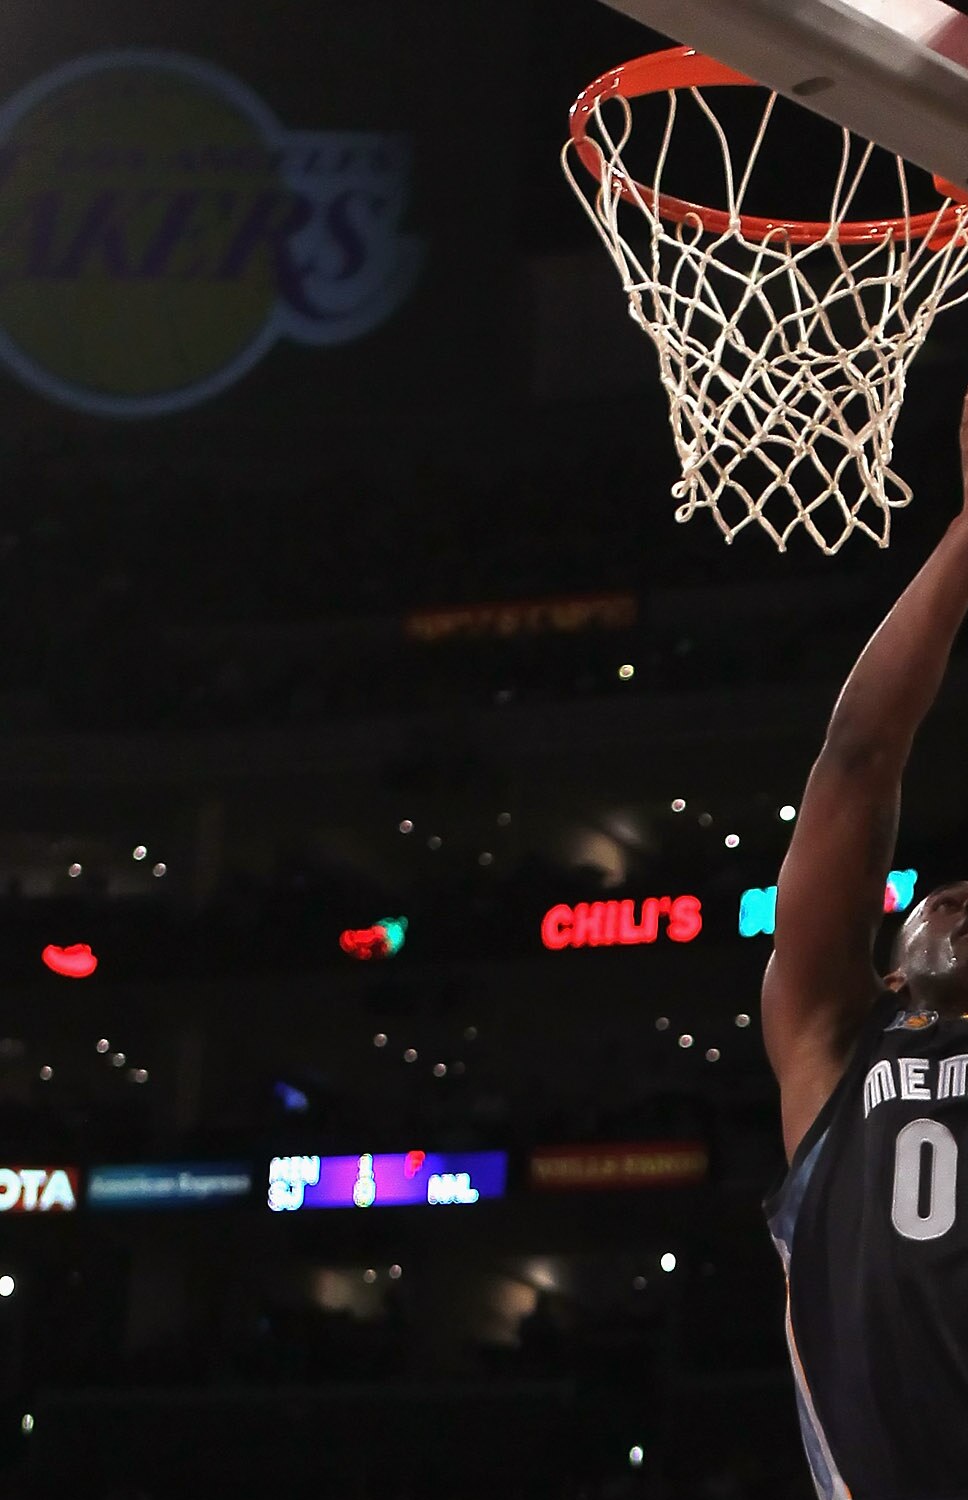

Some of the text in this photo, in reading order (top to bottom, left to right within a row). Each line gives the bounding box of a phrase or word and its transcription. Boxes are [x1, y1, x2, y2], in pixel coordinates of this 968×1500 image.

[0, 148, 387, 322] AKERS
[541, 895, 702, 949] CHILI'S
[0, 1167, 76, 1212] OTA
